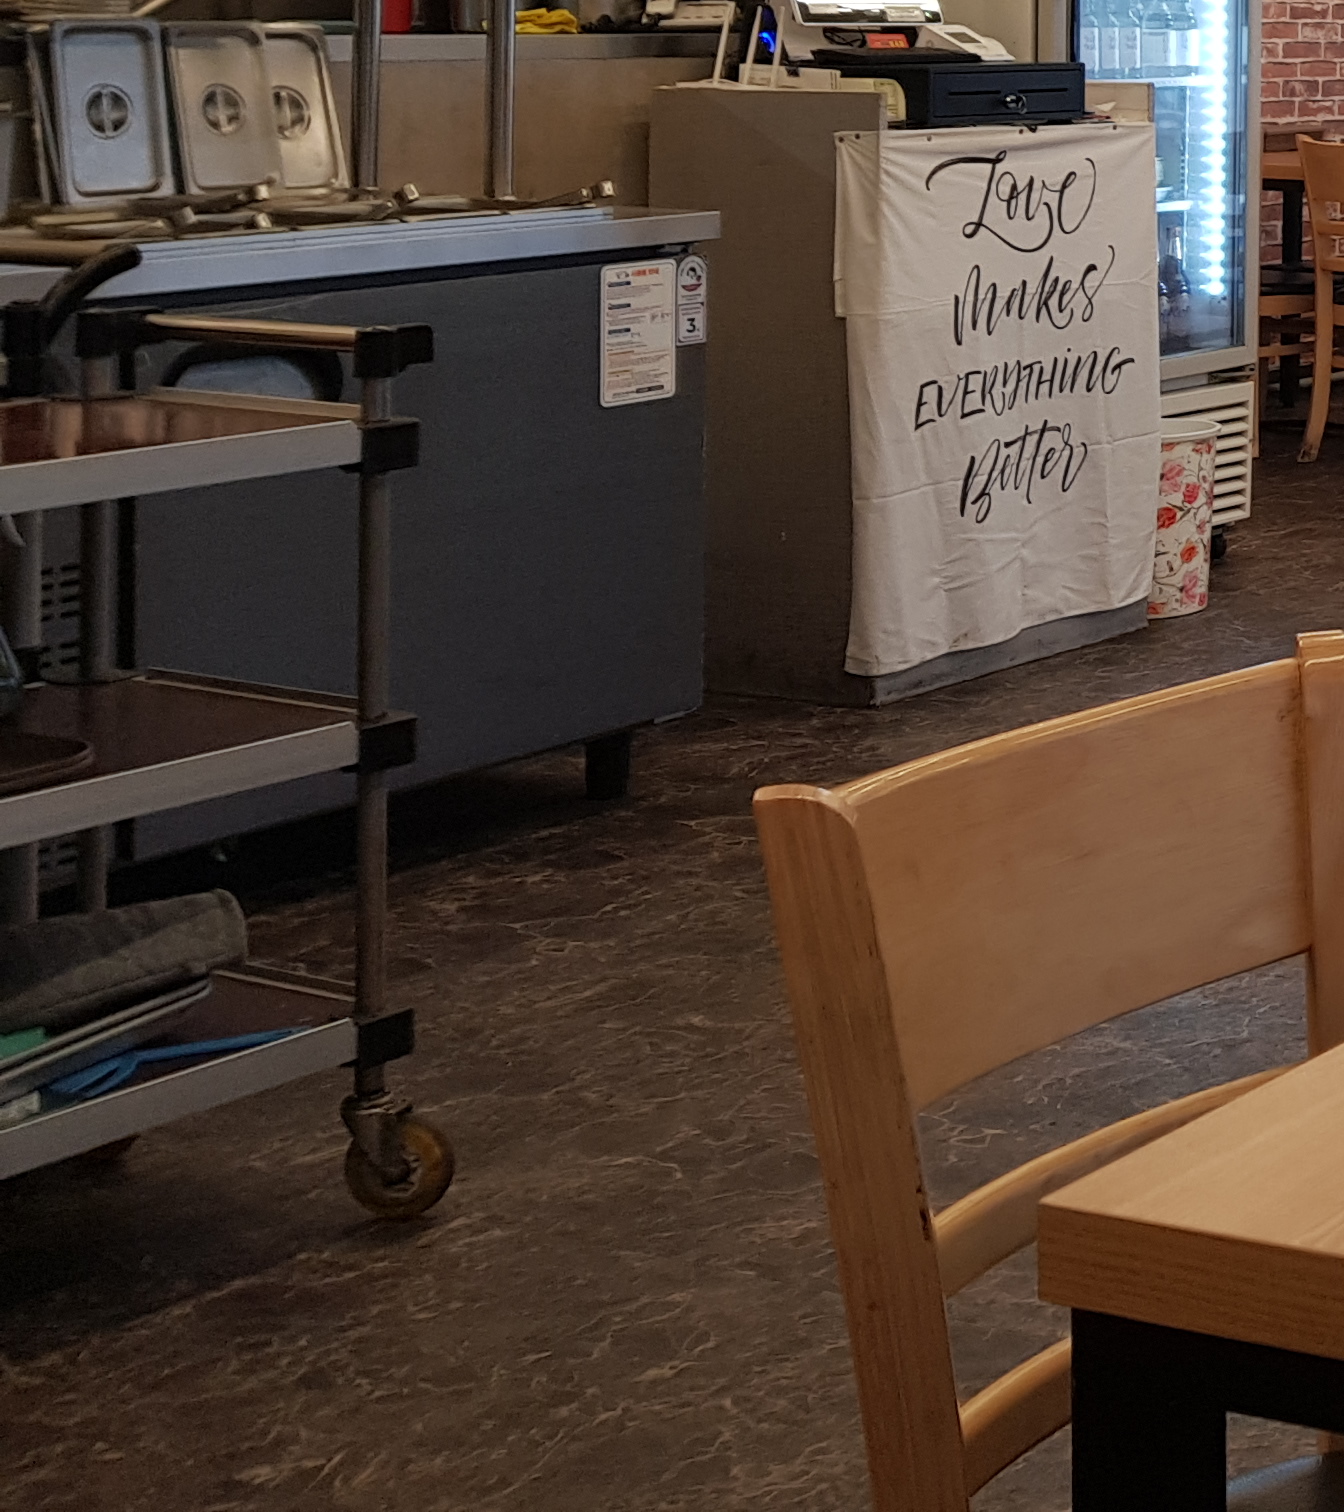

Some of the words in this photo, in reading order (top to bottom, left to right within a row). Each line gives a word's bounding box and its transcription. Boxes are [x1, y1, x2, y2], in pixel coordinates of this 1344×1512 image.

[927, 150, 1097, 252] Love
[686, 318, 696, 333] 3
[954, 245, 1115, 346] Makes
[960, 419, 1088, 524] Better
